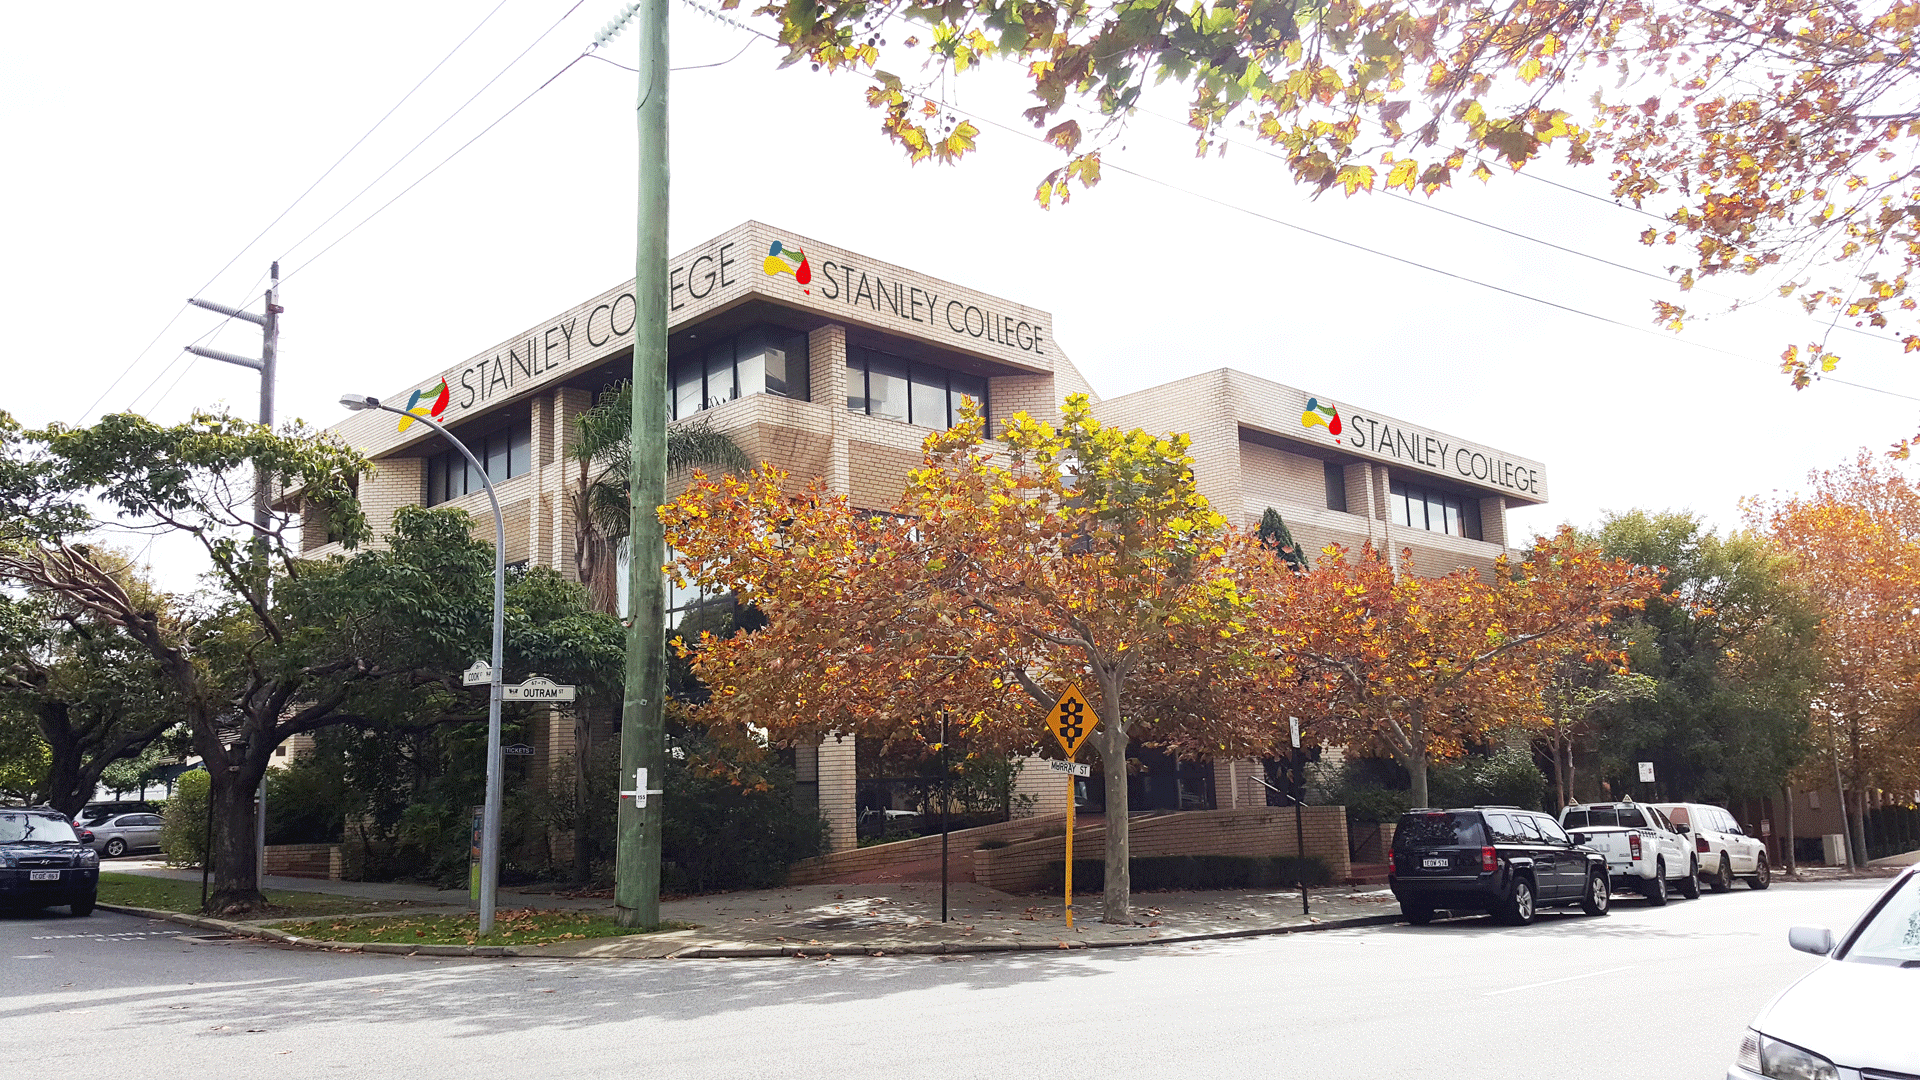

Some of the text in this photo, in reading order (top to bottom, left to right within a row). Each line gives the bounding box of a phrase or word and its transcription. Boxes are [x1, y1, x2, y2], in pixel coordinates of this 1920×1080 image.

[460, 242, 736, 409] STANLEY COEGE
[821, 261, 1044, 355] STANLEY COLLEGE
[1350, 415, 1538, 495] STANLEY COLLEGE
[523, 688, 558, 698] OUTRAM
[1051, 761, 1087, 775] MURRAY ST
